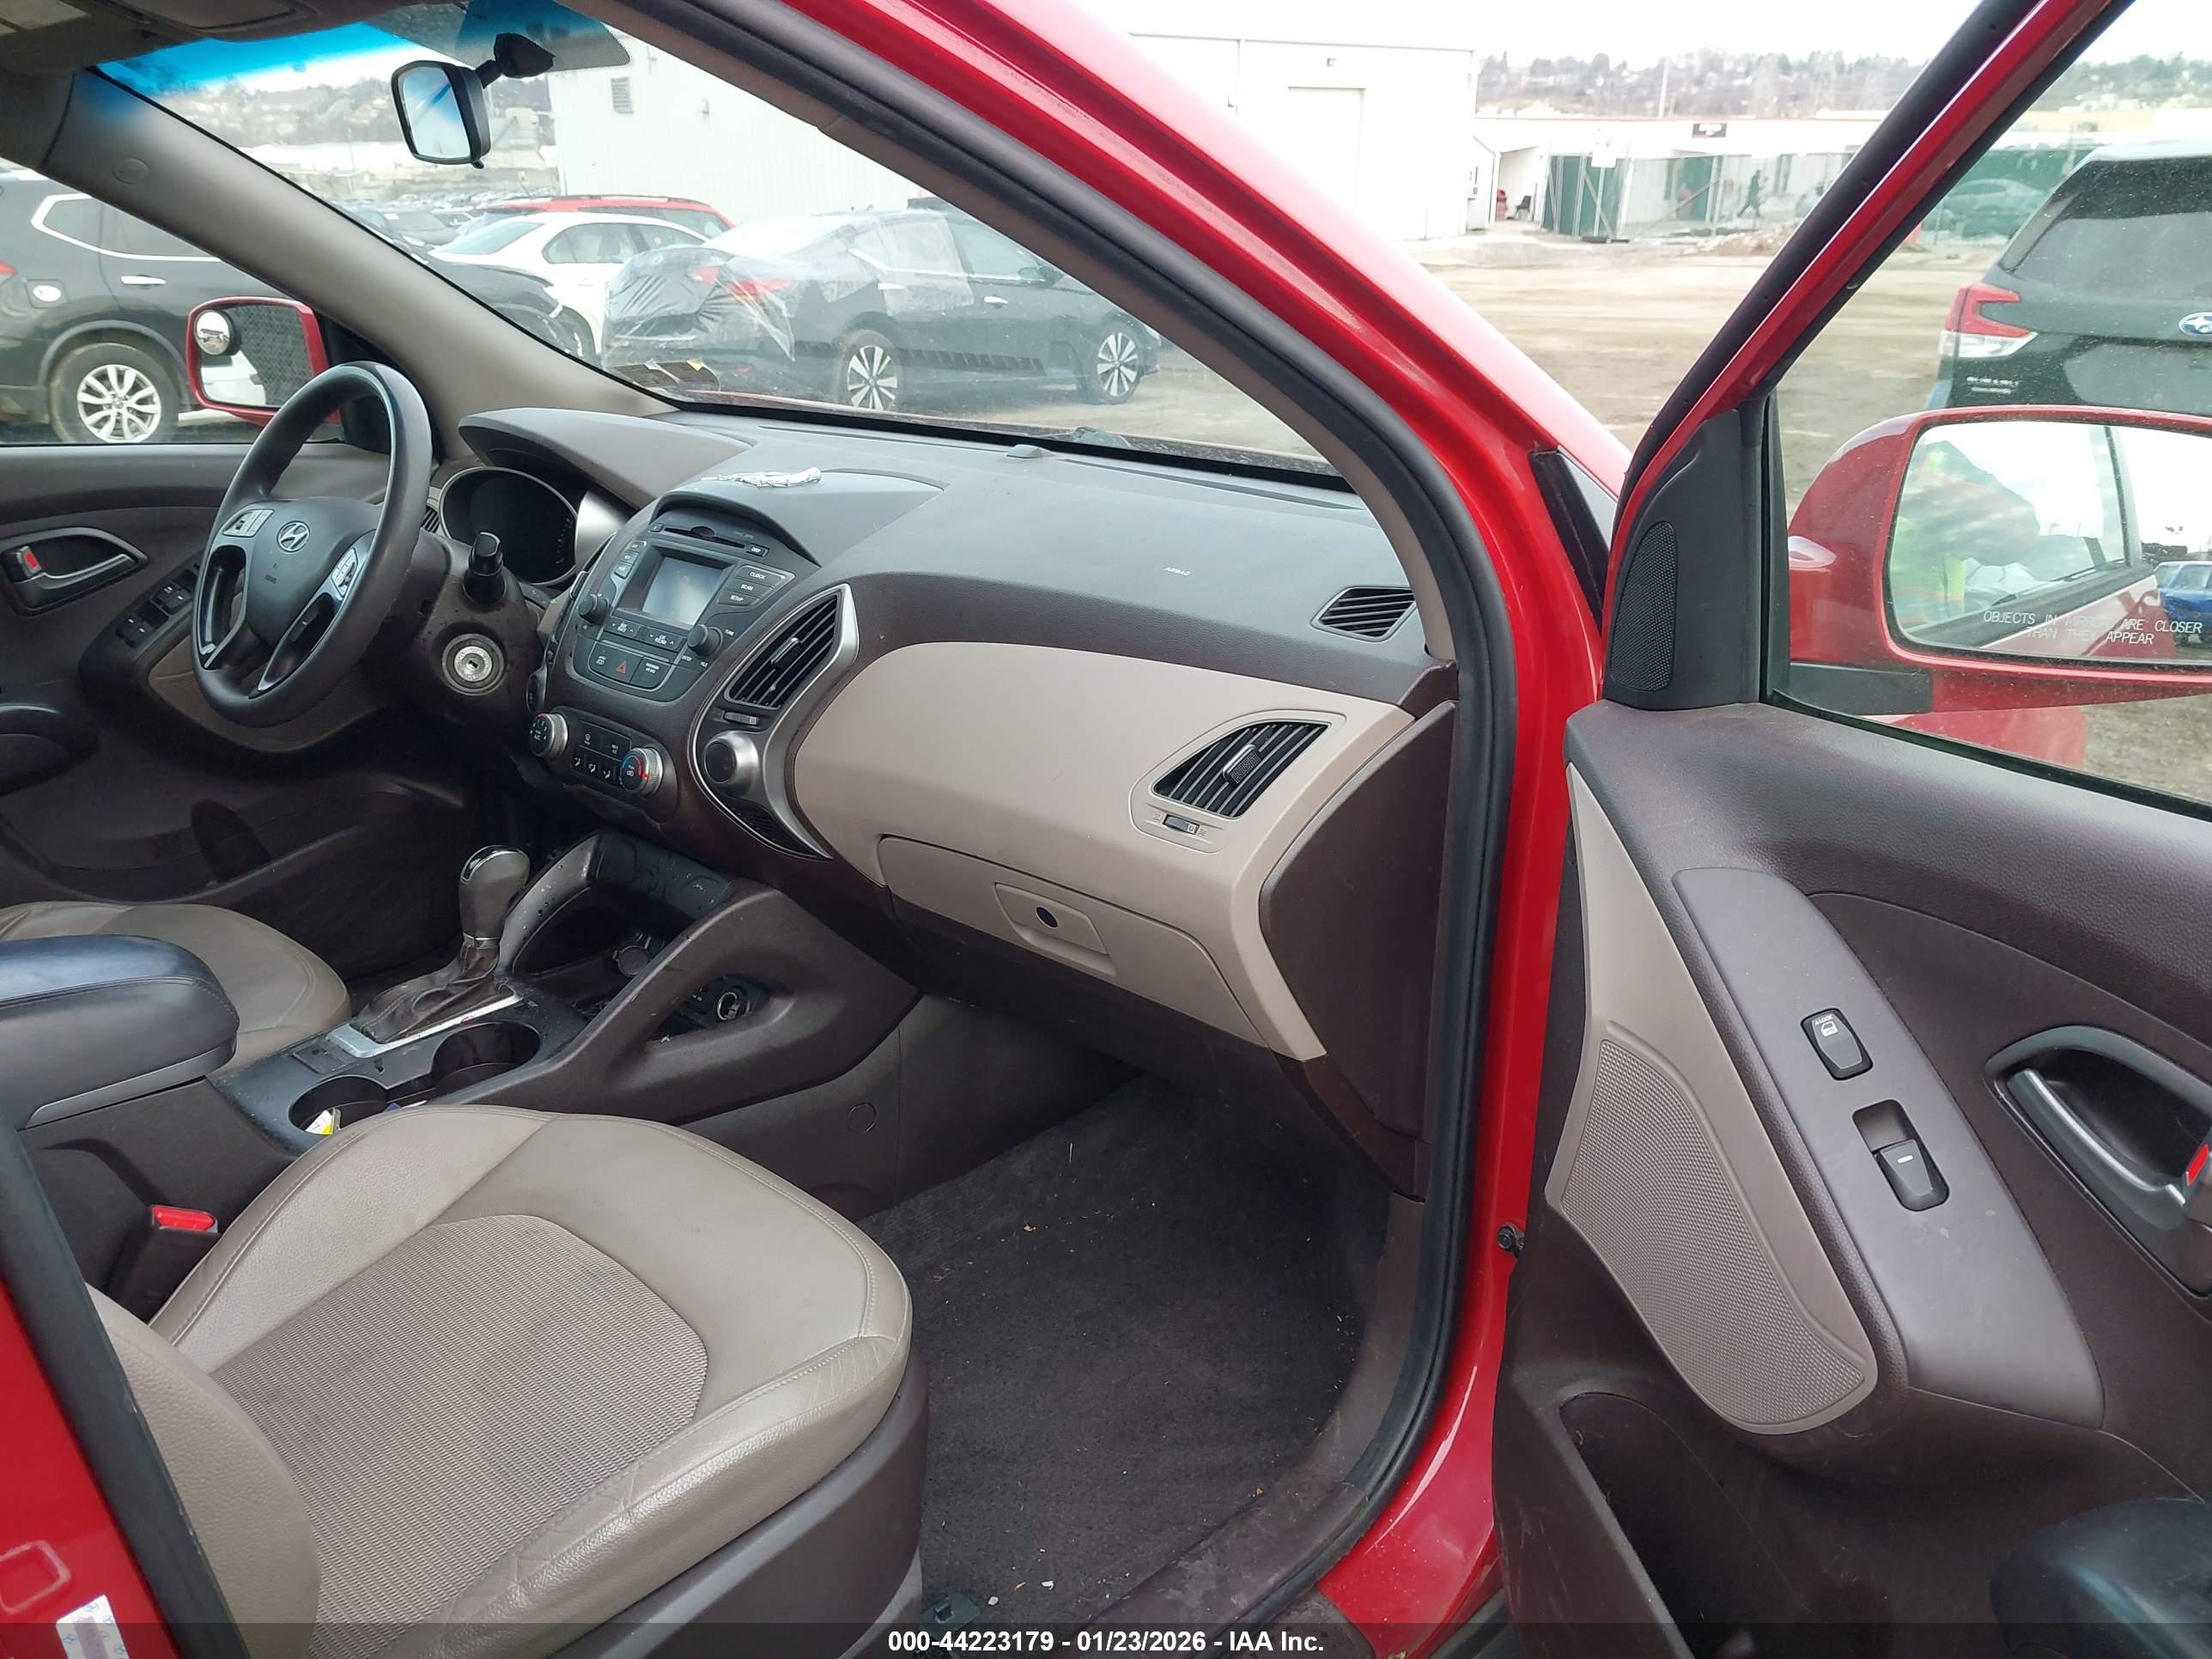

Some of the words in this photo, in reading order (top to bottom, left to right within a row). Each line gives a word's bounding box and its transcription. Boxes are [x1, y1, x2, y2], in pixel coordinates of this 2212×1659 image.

[750, 571, 766, 580] CLOCK
[740, 583, 754, 592] SCAN
[1983, 611, 2036, 625] OBJECTS
[2045, 614, 2058, 626] IN
[2122, 618, 2145, 631] ARE
[2154, 620, 2203, 634] CLOSER
[2027, 626, 2058, 640] THAN
[2106, 630, 2154, 645] APPEAR
[1818, 1014, 1833, 1024] LOCK
